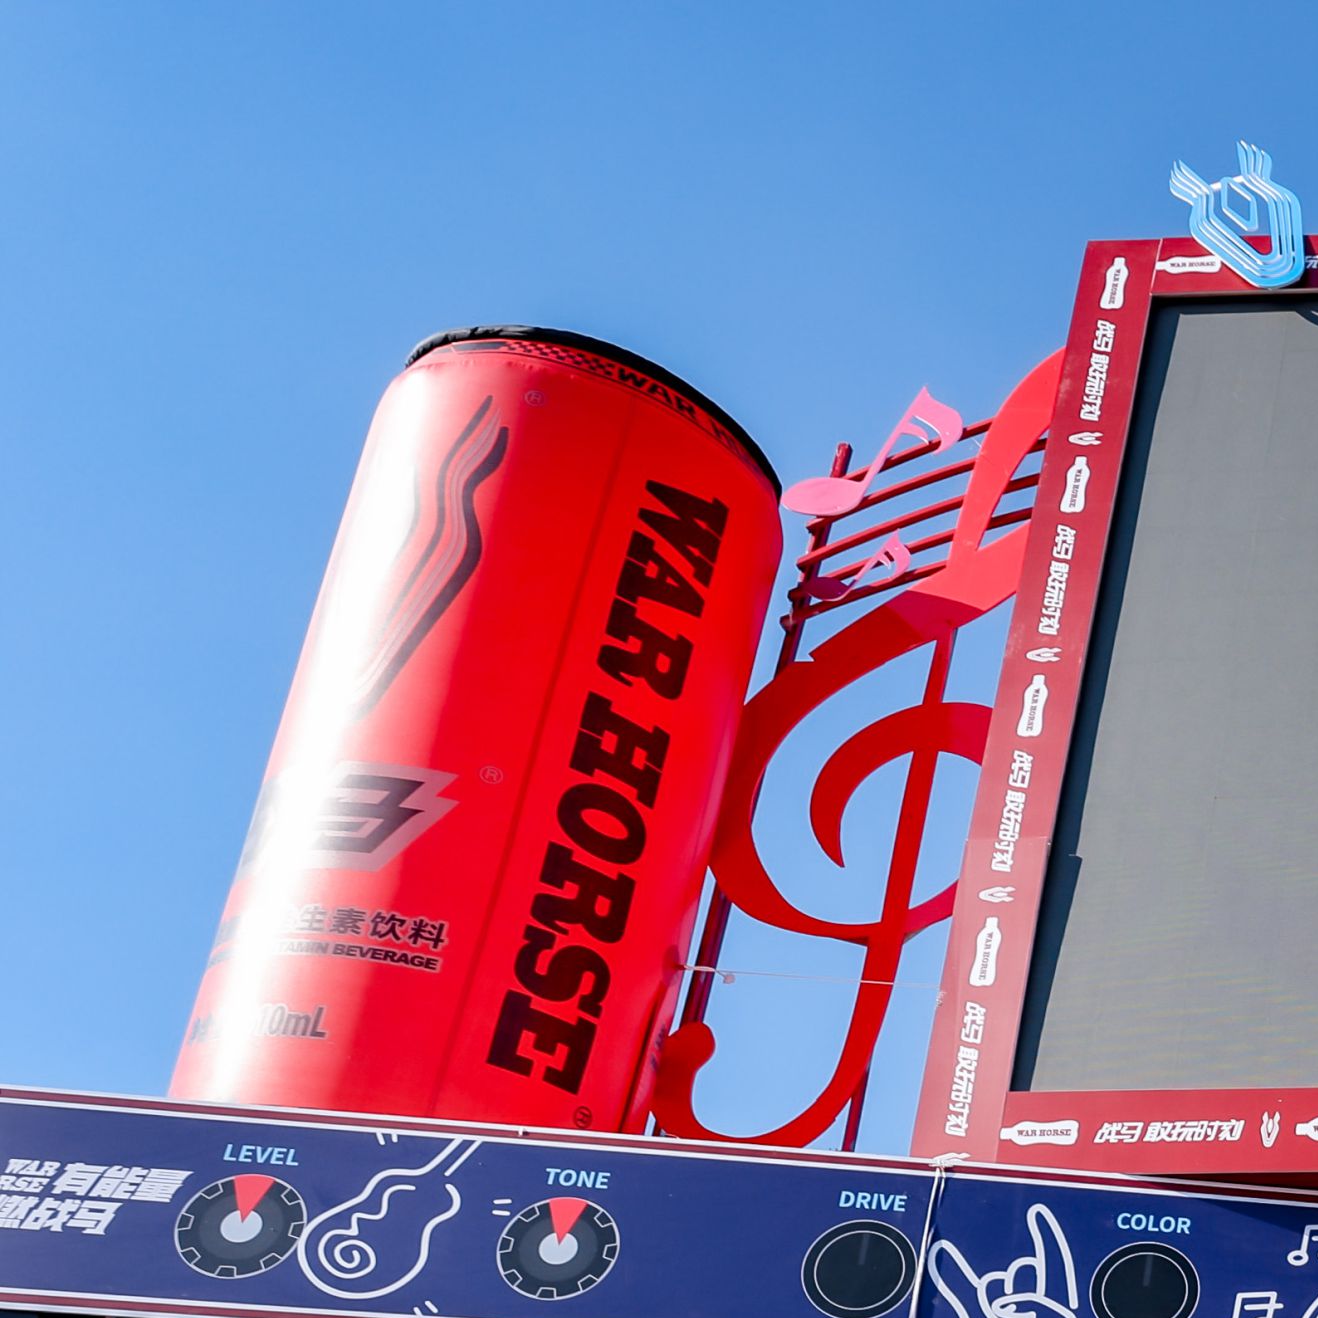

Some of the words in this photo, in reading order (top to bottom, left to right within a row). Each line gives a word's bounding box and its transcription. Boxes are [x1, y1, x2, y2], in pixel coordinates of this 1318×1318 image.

[615, 367, 698, 420] WAR
[597, 479, 729, 702] WAR
[1030, 686, 1041, 708] WAR
[1024, 708, 1038, 733] HORSE
[1009, 751, 1033, 788] 战马
[486, 692, 671, 1096] HORSE
[332, 943, 440, 971] BEVERAGE
[984, 931, 995, 953] WAR
[977, 953, 993, 983] HORSE
[961, 1002, 986, 1044] 战马
[1016, 1129, 1038, 1138] WAR
[1038, 1128, 1073, 1137] HORSE
[1094, 1122, 1144, 1143] 战马
[1143, 1119, 1244, 1142] 敢玩时刻
[4, 1158, 61, 1176] WAR
[51, 1162, 195, 1203] 有能量
[224, 1144, 298, 1166] LEVEL
[546, 1168, 610, 1188] TONE
[839, 1191, 907, 1211] DRIVE
[1117, 1213, 1190, 1234] COLOR
